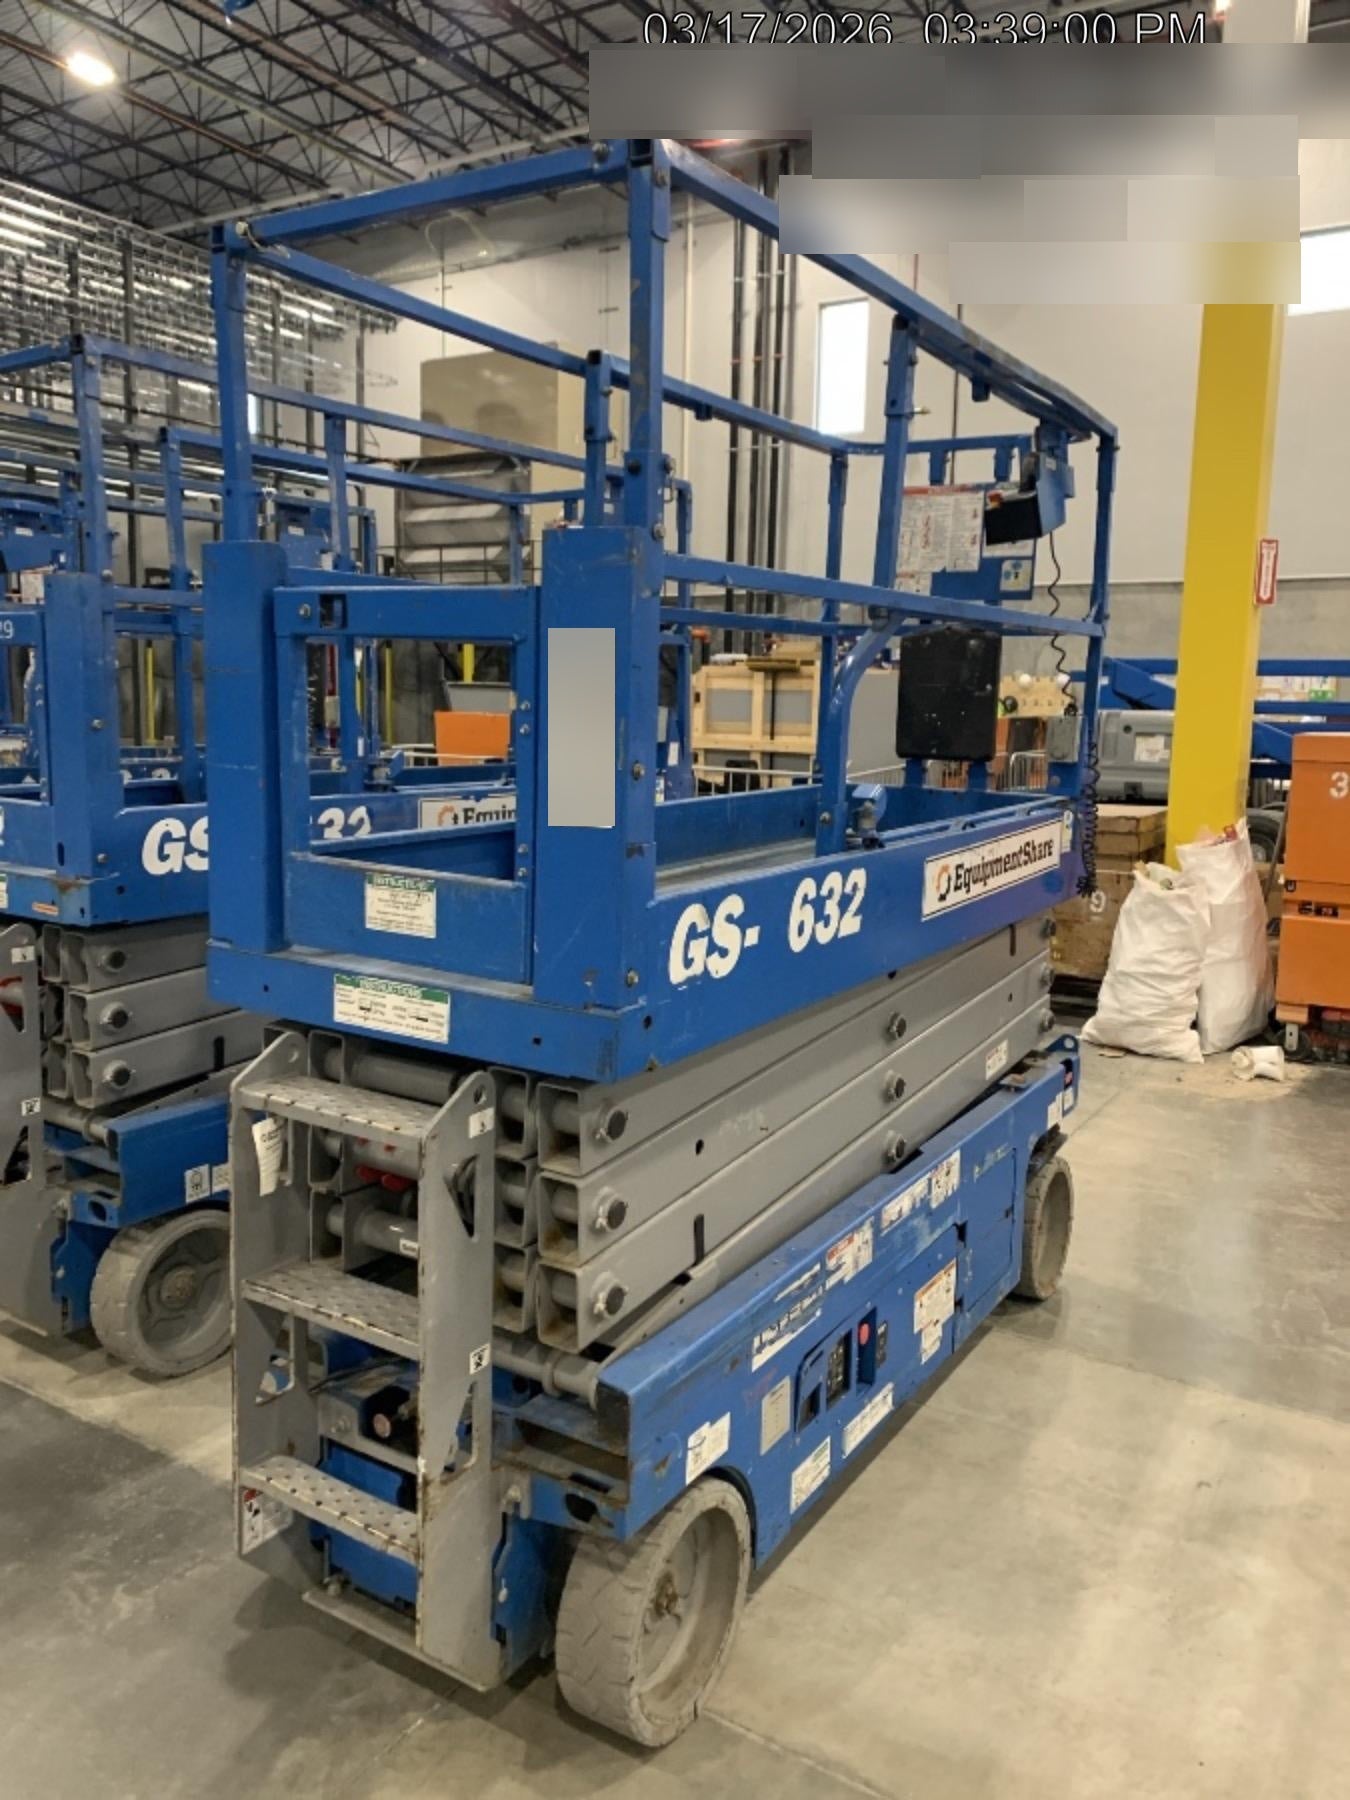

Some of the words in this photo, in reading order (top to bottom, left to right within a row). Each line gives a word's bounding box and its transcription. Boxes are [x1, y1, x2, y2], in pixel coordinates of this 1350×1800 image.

[954, 839, 1054, 894] EquipmentShare
[668, 894, 760, 985] GS-
[788, 867, 867, 953] 632
